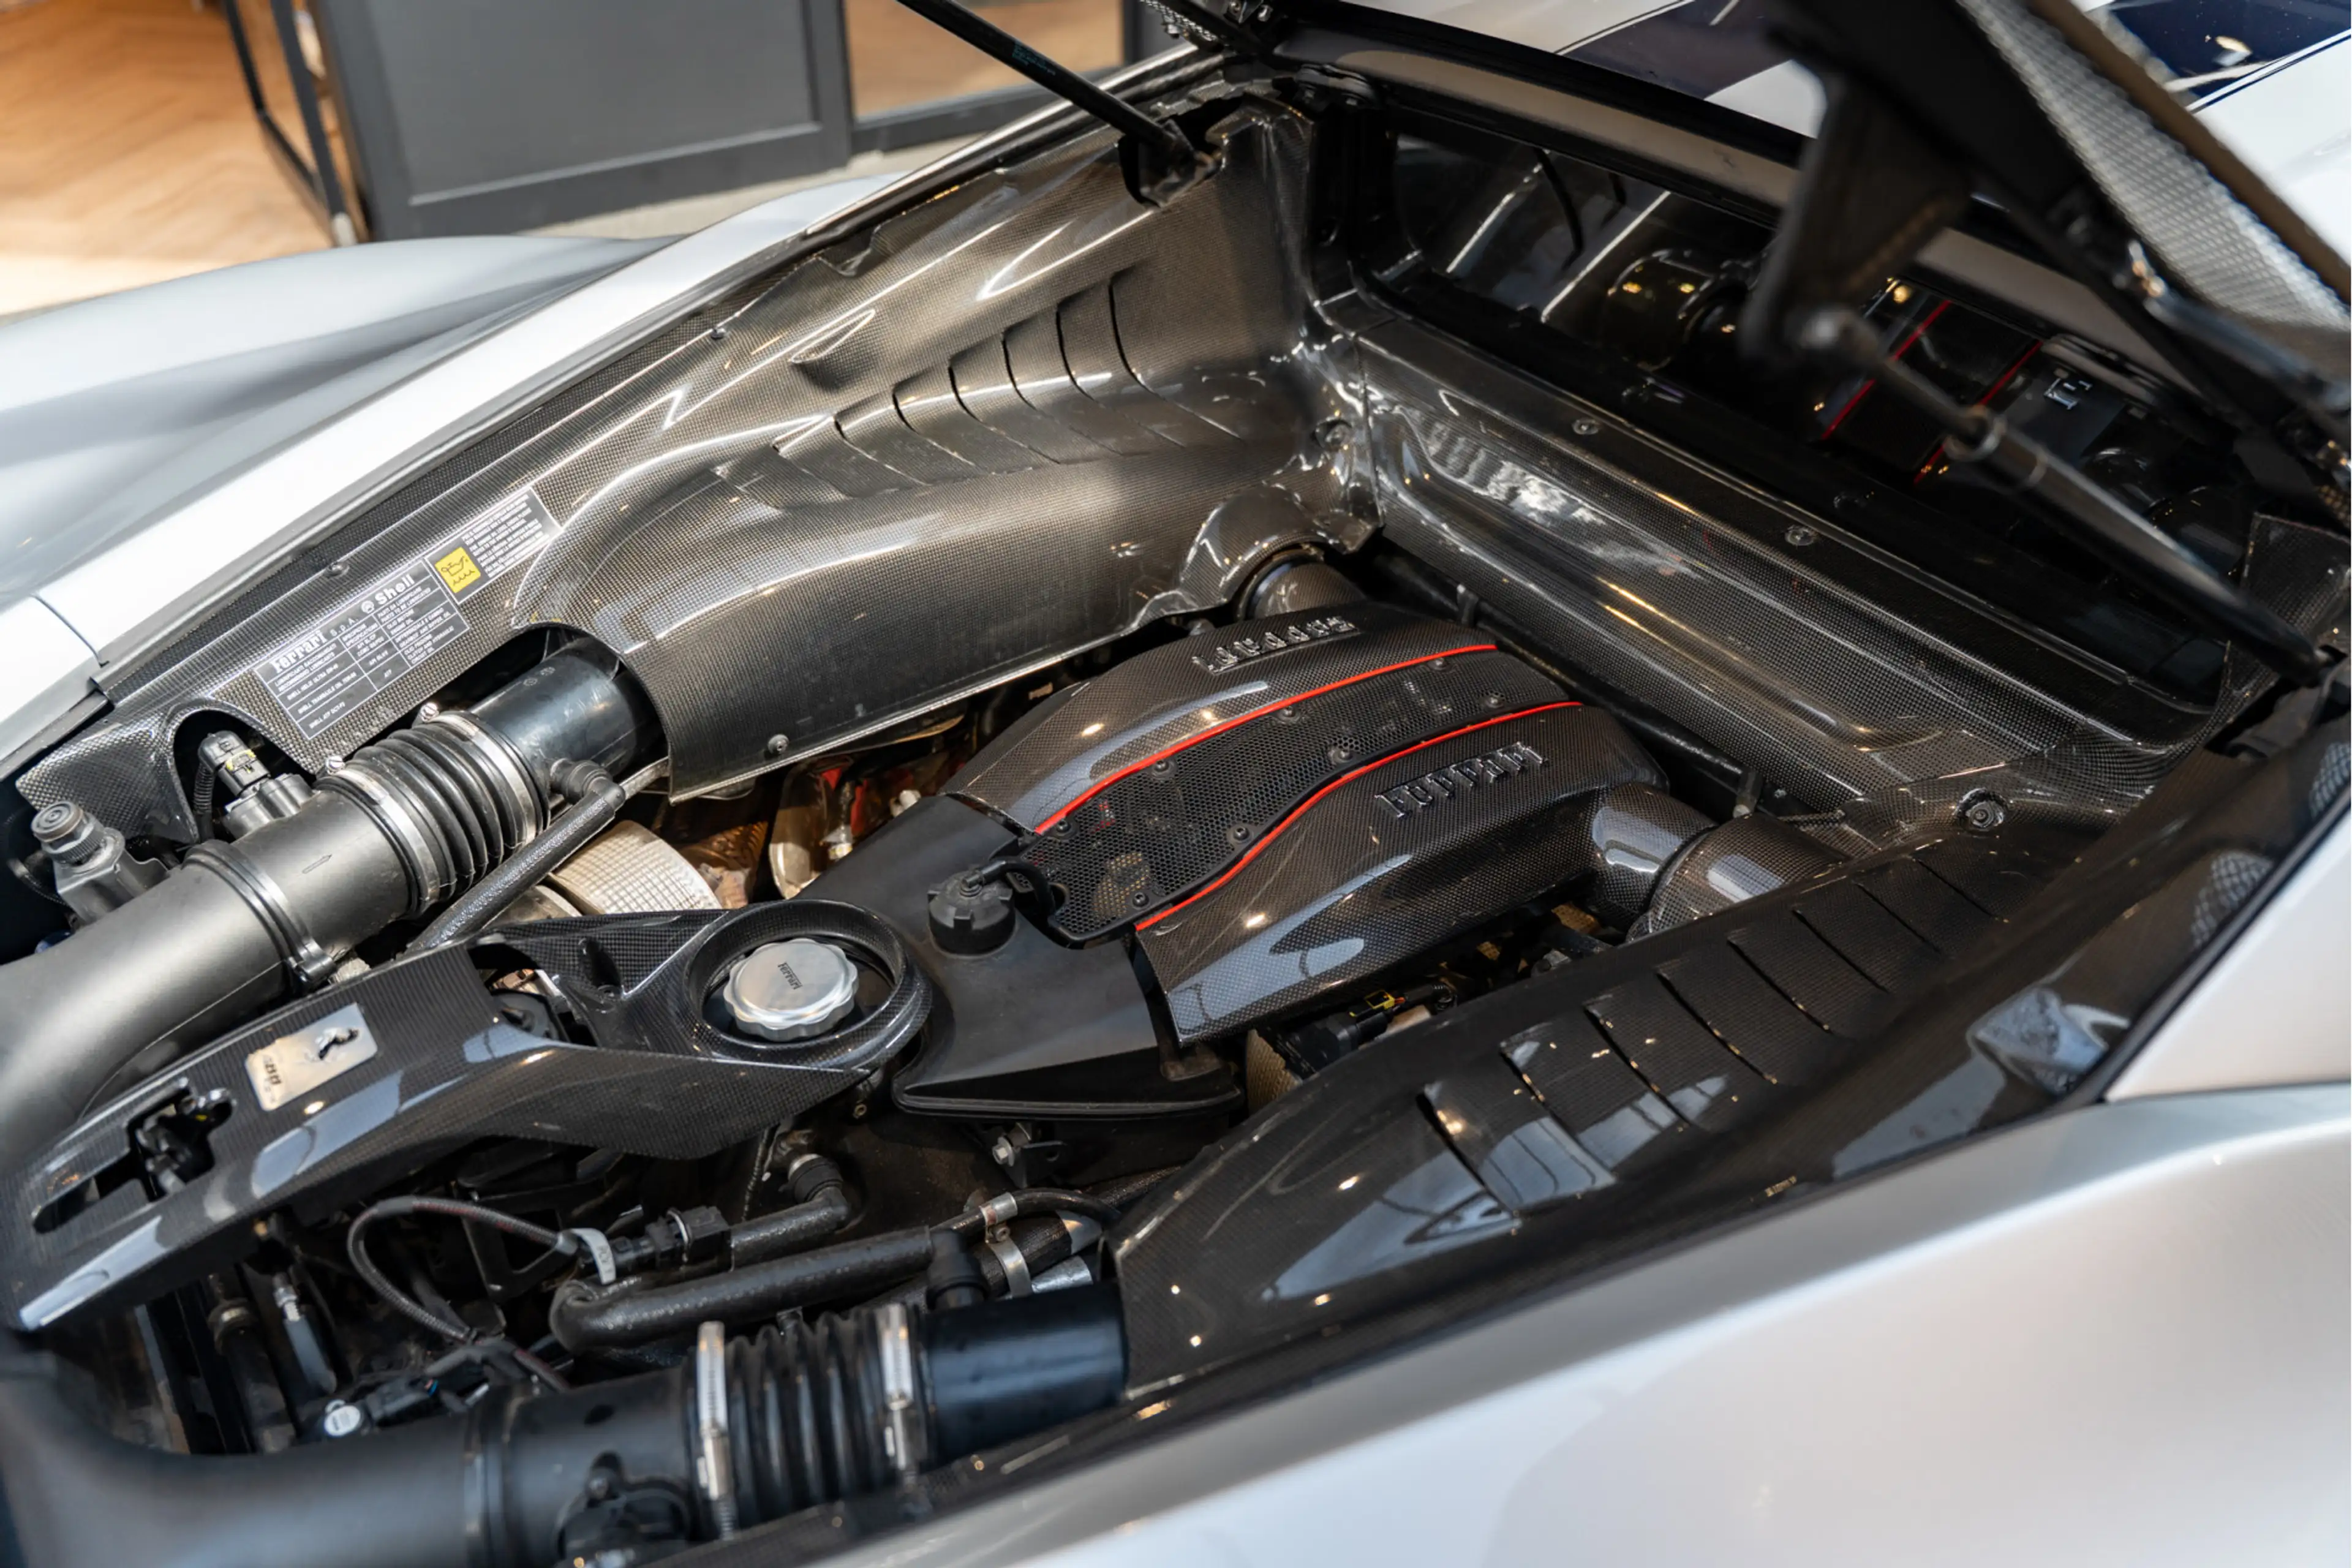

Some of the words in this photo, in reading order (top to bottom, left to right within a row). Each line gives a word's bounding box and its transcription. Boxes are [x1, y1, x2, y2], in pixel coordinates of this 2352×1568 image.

[375, 574, 415, 606] Shell
[270, 630, 328, 674] Ferrari
[1191, 616, 1359, 675] Ferrari
[1374, 741, 1548, 818] Ferrari
[778, 962, 803, 990] Ferrari
